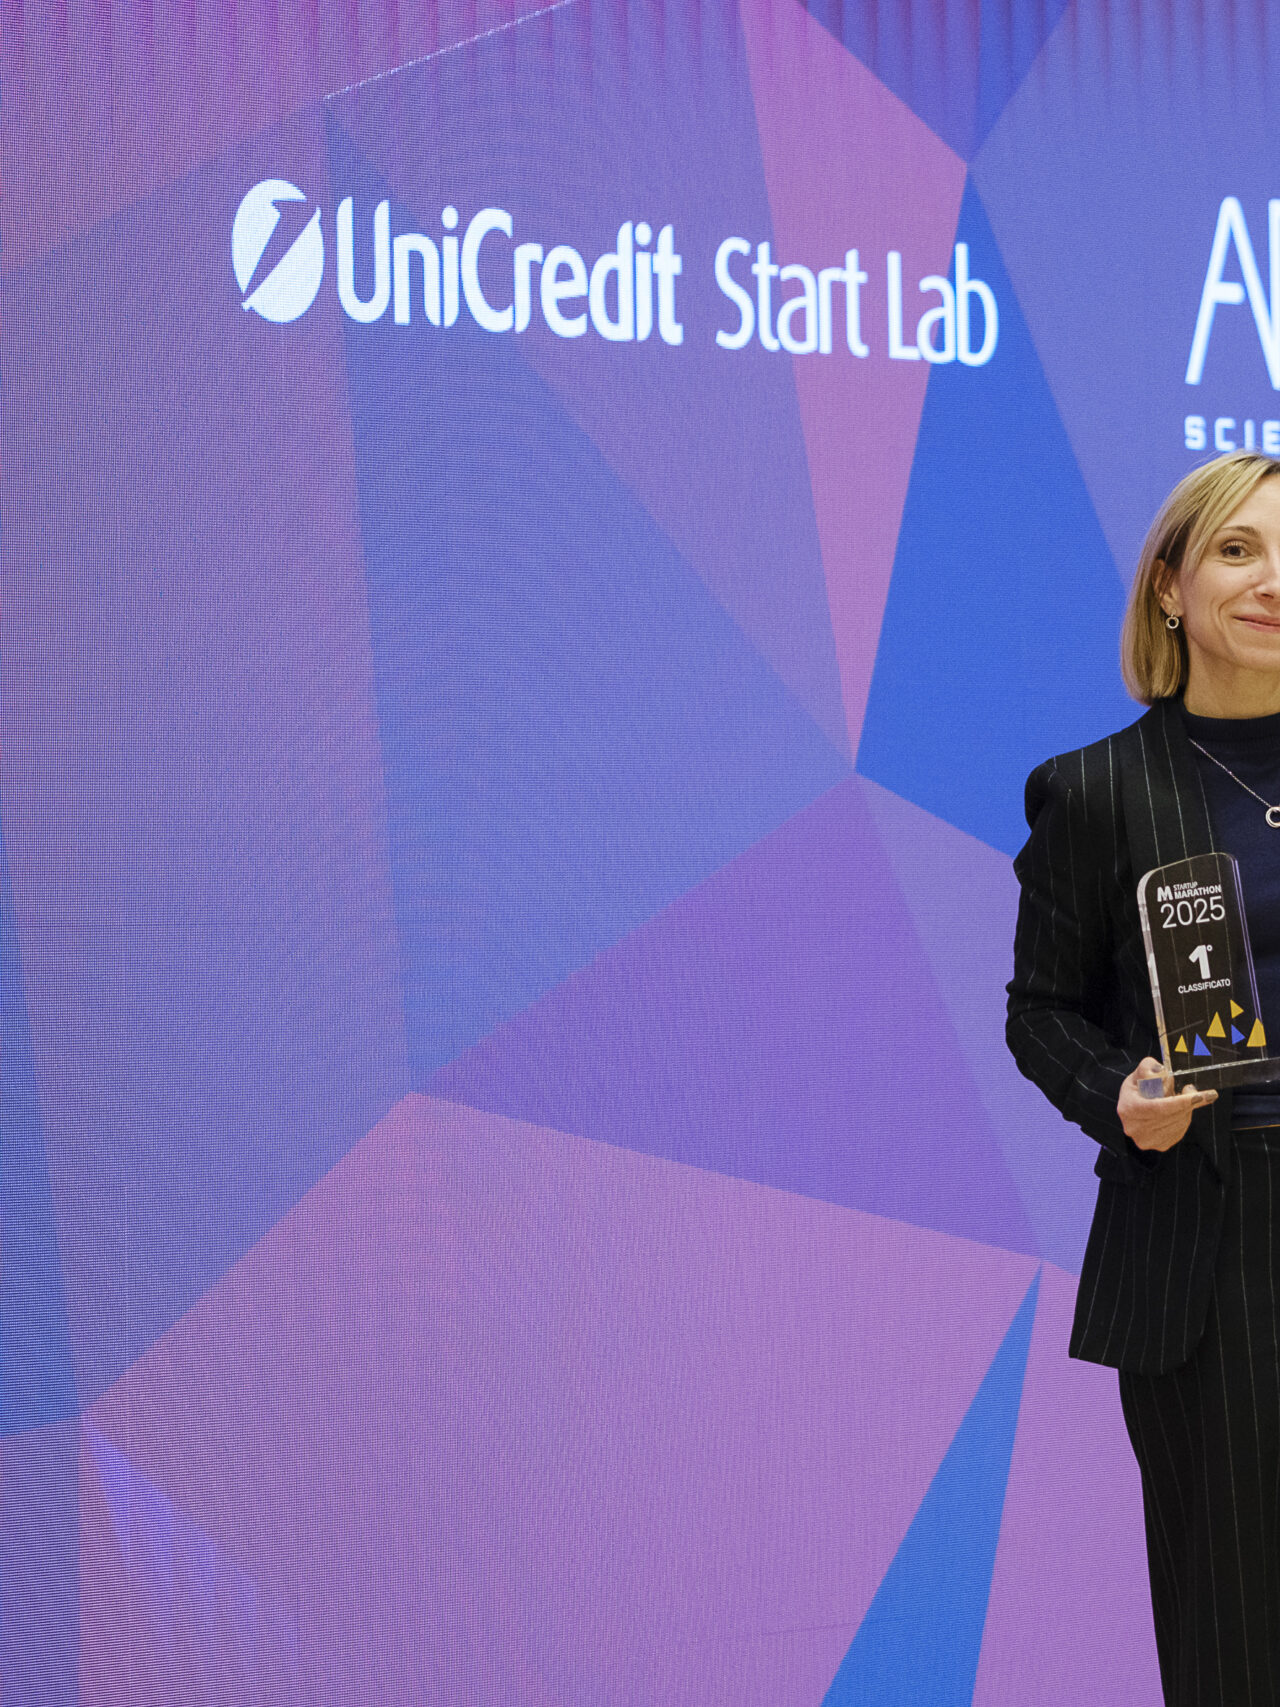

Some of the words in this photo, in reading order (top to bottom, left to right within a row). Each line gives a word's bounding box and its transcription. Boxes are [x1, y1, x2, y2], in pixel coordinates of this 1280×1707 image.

[337, 197, 683, 345] UniCredit
[715, 237, 869, 358] Start
[886, 243, 998, 366] Lab
[1173, 881, 1198, 891] STARTUP
[1174, 885, 1222, 900] MARATHON
[1160, 896, 1226, 929] 2025
[1178, 978, 1231, 994] CLASSIFICATO
